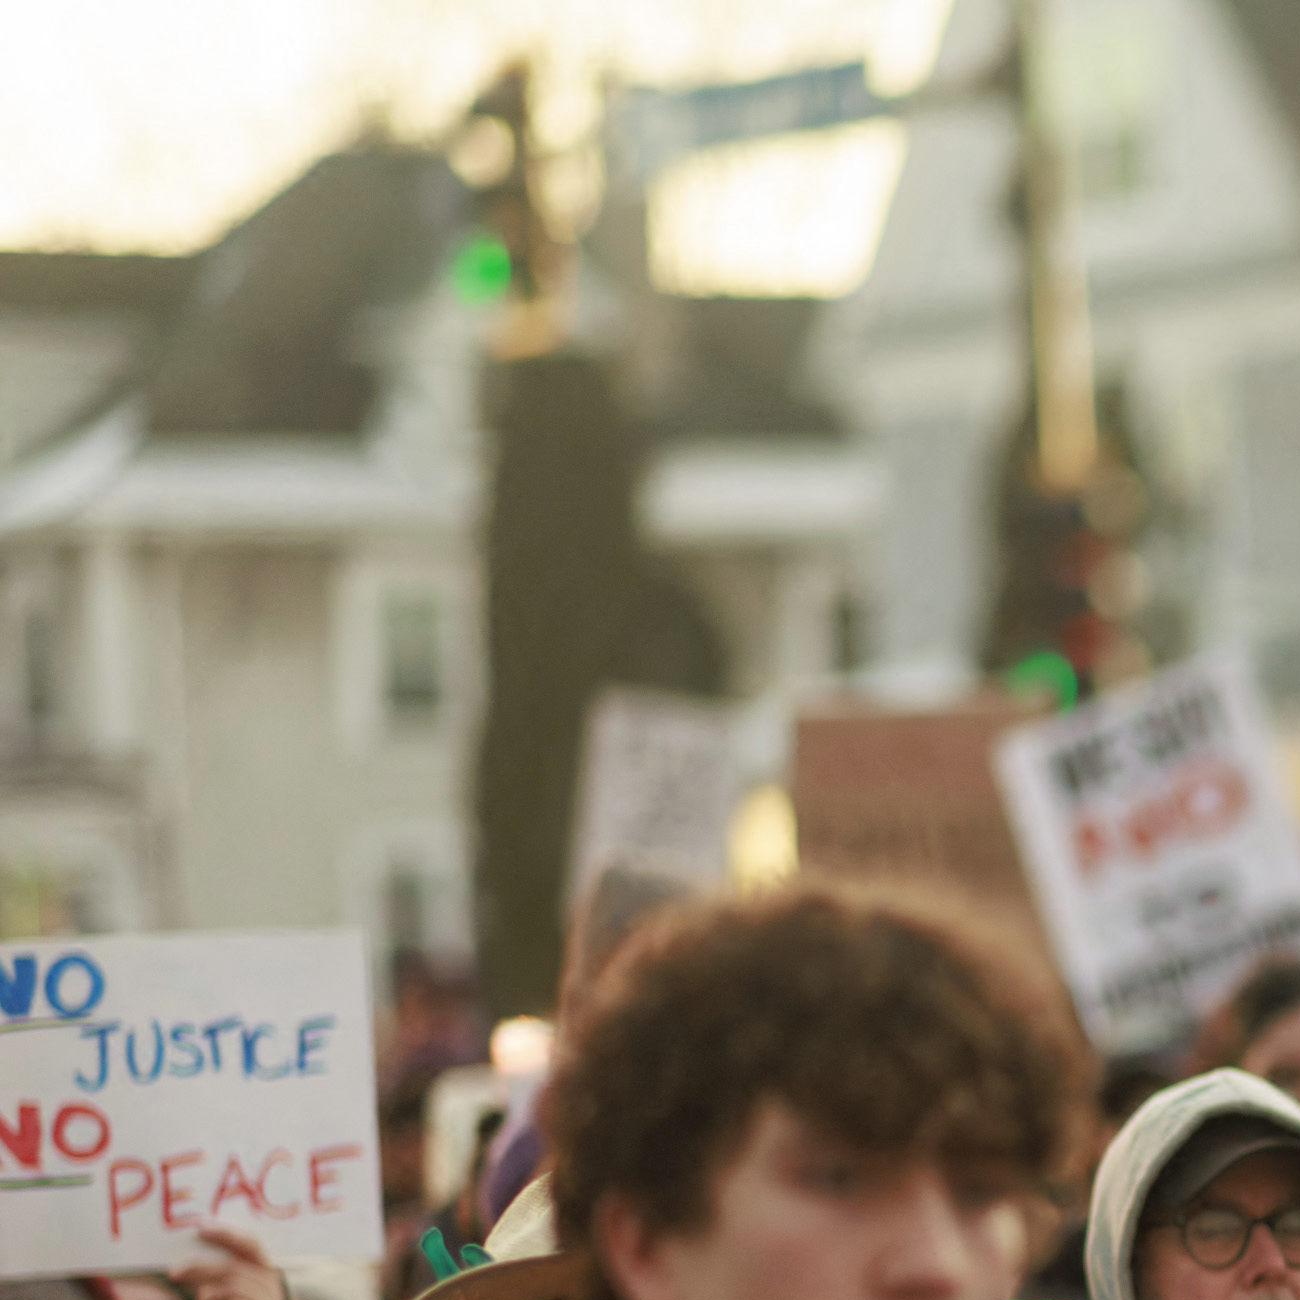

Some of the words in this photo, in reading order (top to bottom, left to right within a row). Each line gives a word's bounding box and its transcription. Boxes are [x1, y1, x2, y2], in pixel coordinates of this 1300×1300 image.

[0, 951, 105, 1018] NO
[75, 1013, 336, 1092] JUSTICE
[0, 1100, 111, 1171] NO
[107, 1143, 363, 1241] PEACE
